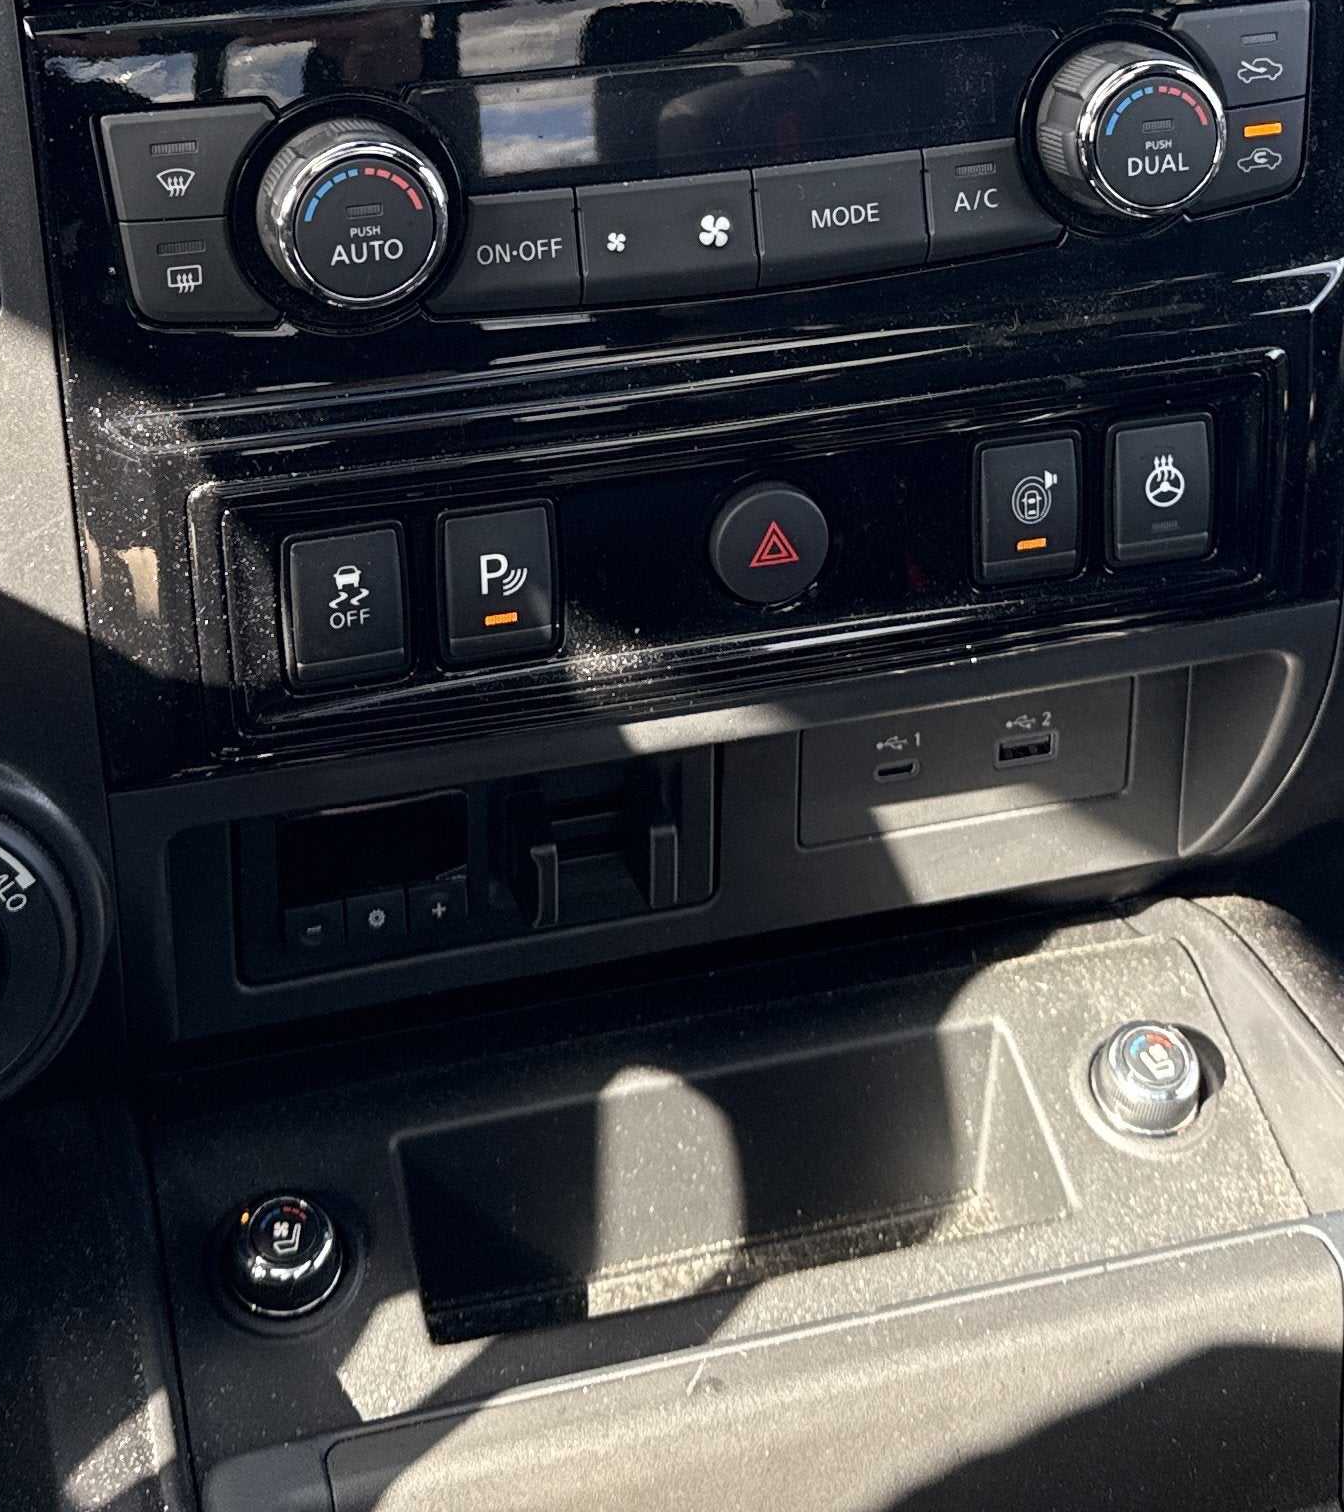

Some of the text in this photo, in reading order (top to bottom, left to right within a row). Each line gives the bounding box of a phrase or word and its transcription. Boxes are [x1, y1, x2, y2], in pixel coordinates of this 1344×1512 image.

[1144, 139, 1174, 152] PUSH
[1126, 152, 1190, 178] DUAL
[952, 188, 1000, 212] A/C
[810, 202, 881, 230] MODE
[349, 224, 382, 239] PUSH
[330, 238, 405, 267] AUTO
[478, 552, 510, 596] P
[329, 607, 372, 631] OFF
[1041, 711, 1052, 727] 2
[913, 731, 921, 747] 1
